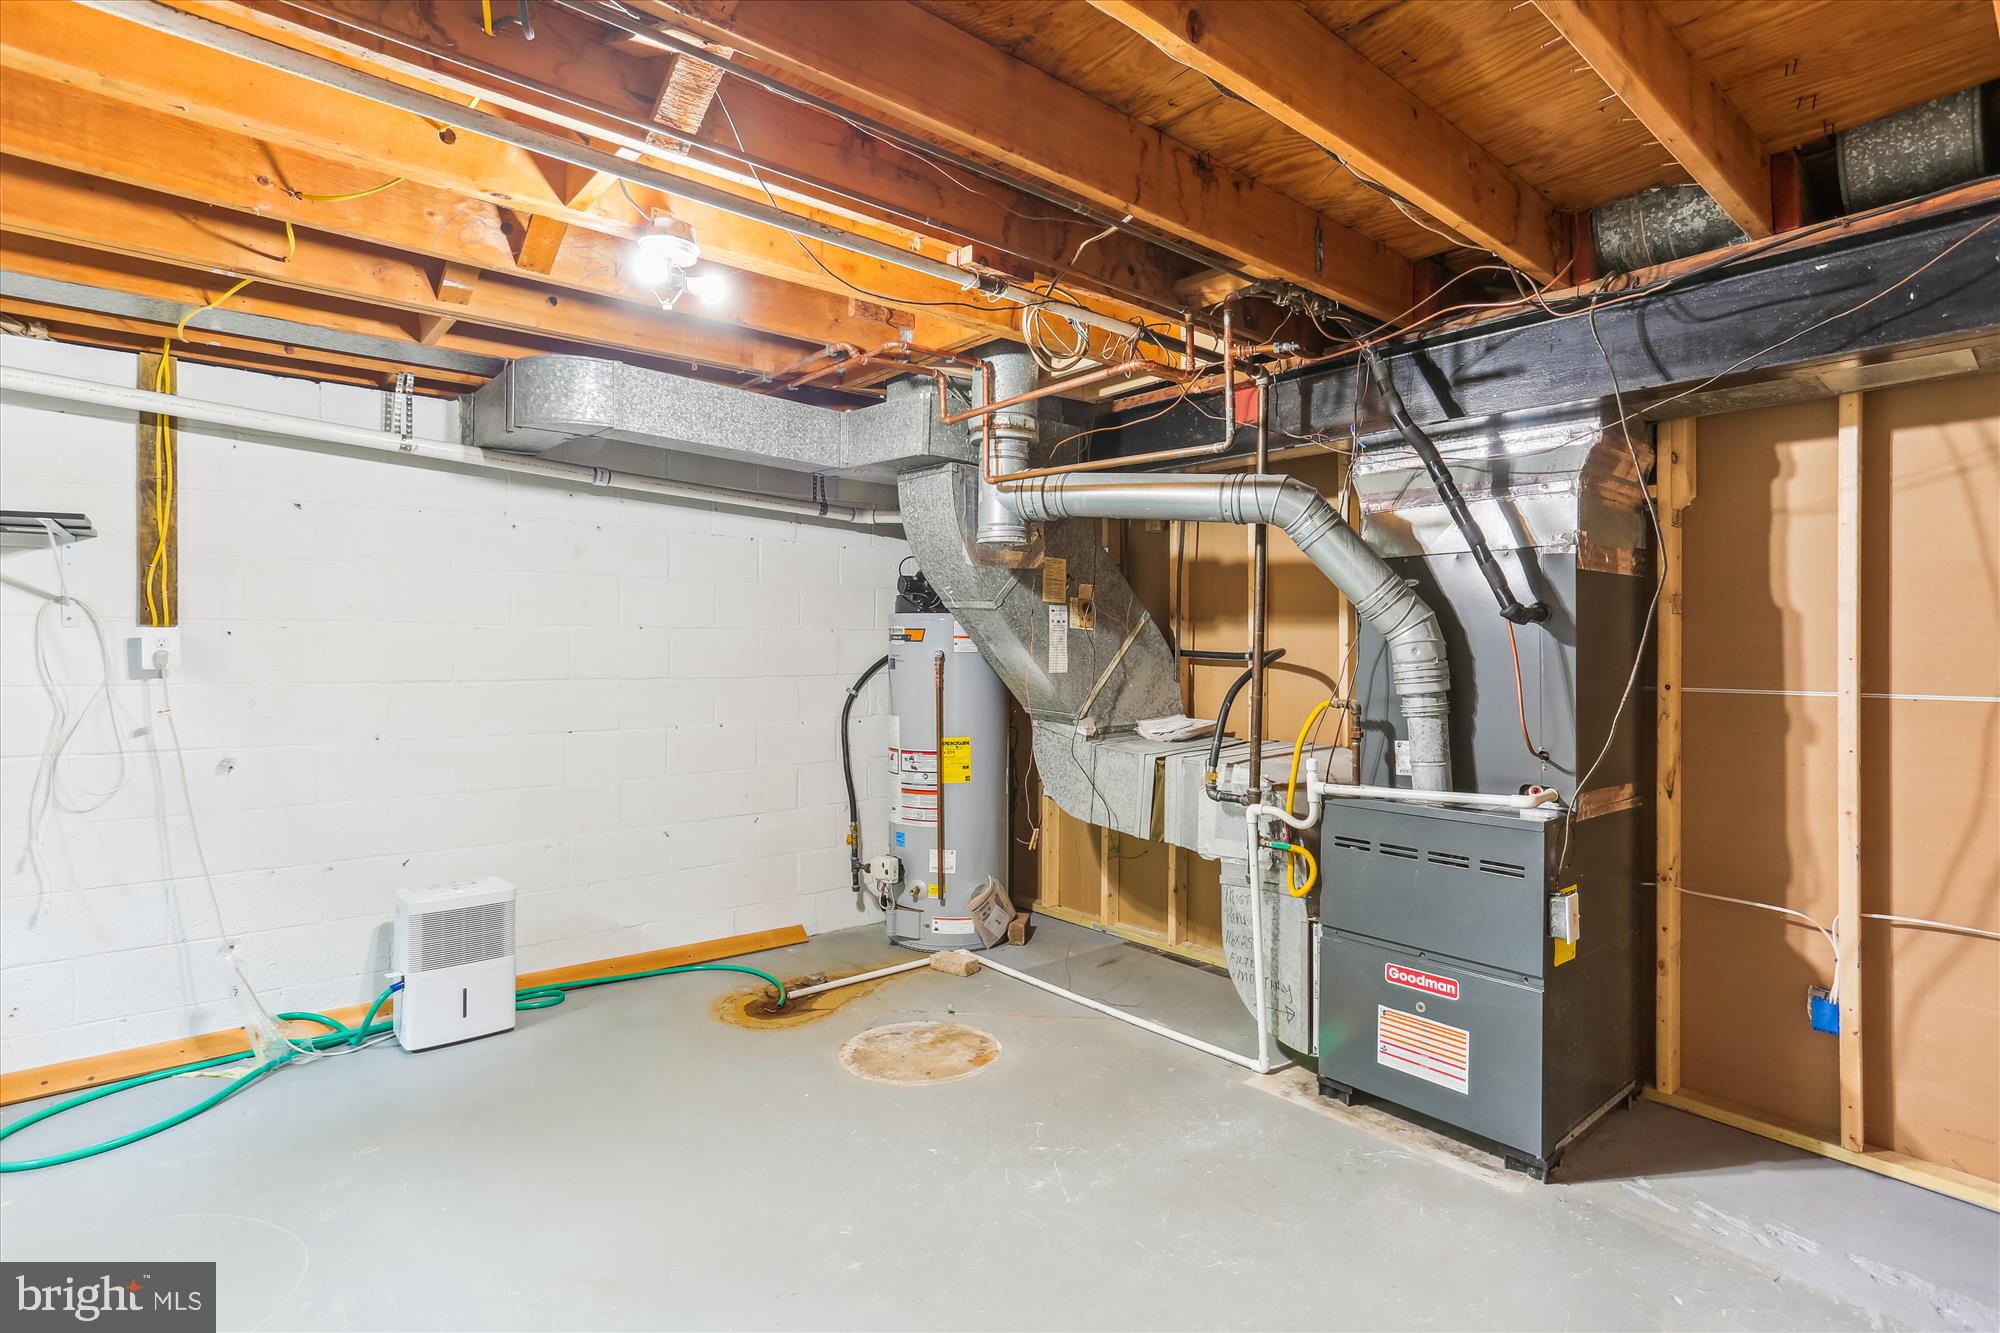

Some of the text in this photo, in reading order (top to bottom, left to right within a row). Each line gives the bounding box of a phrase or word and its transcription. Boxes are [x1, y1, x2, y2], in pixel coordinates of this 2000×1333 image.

[1230, 952, 1255, 969] FILTE
[1237, 969, 1293, 1004] MOTHLY
[1388, 967, 1456, 995] Goodman
